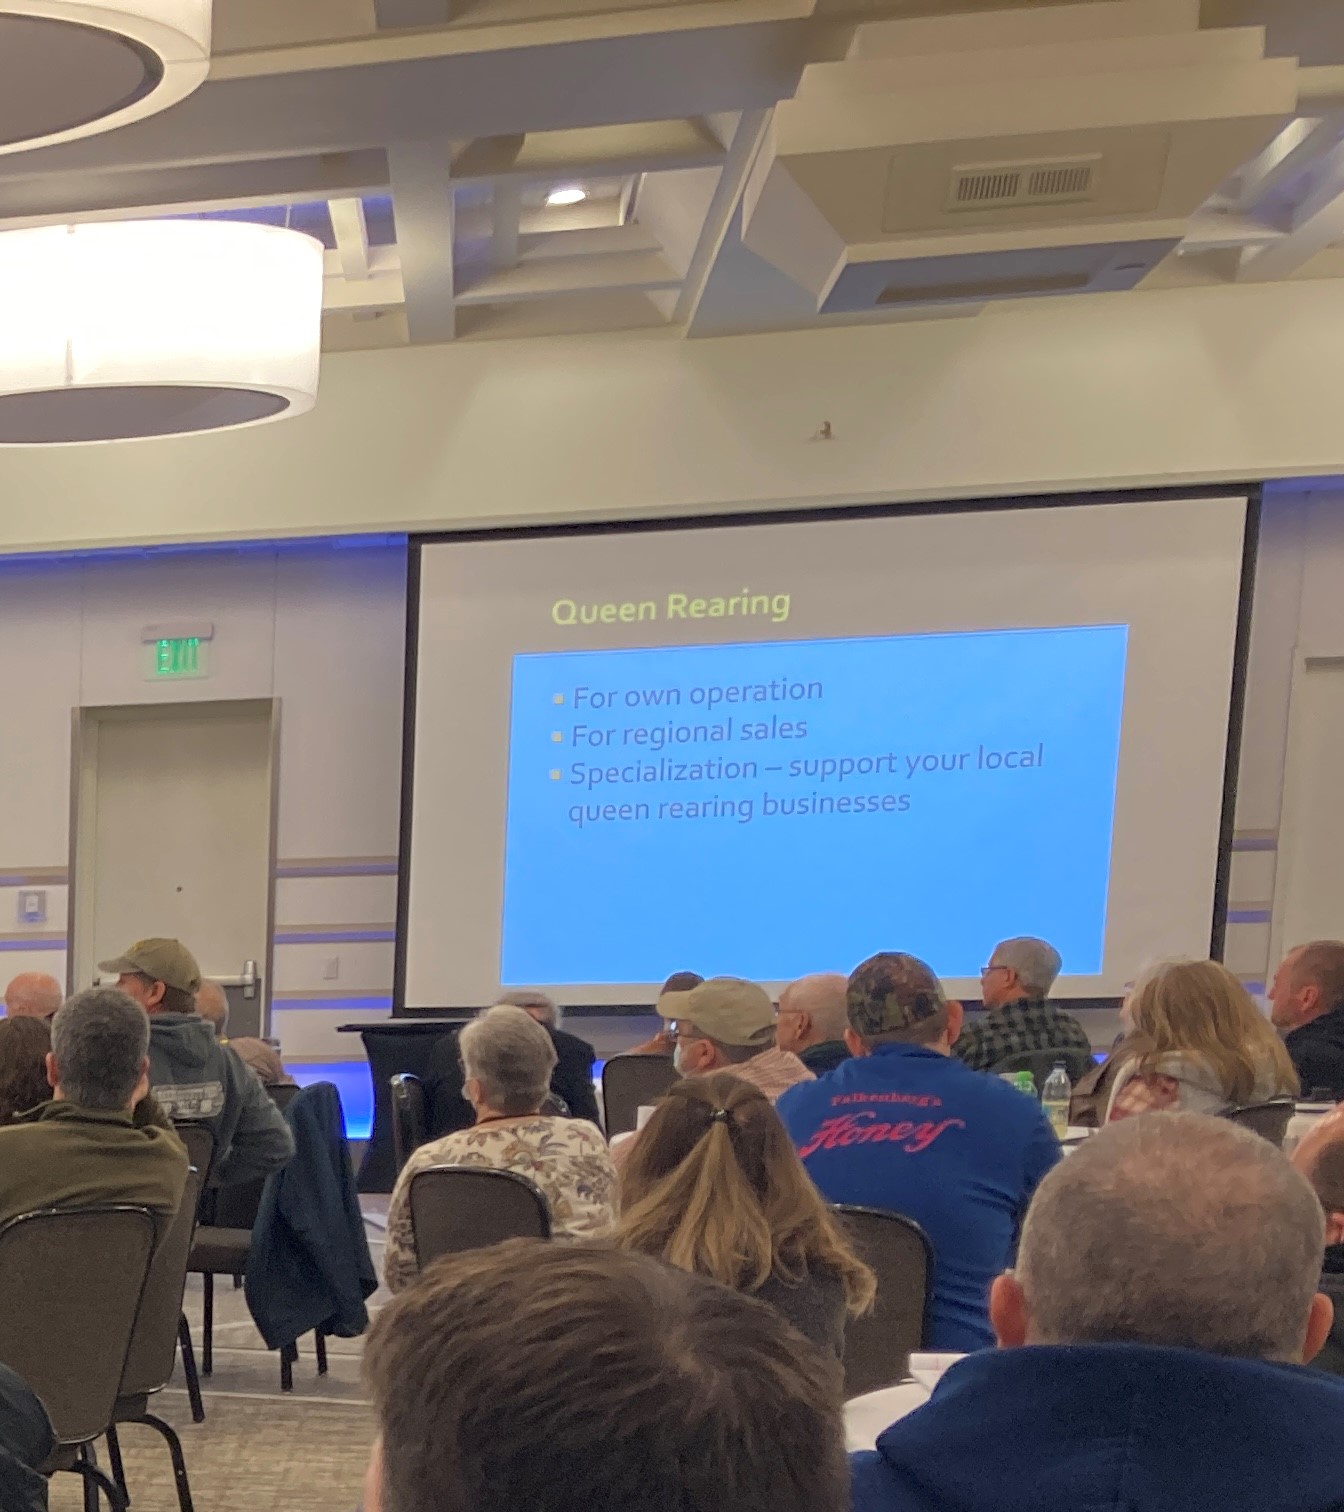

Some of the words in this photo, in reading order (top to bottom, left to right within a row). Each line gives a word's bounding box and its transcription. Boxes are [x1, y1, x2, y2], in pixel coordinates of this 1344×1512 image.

[551, 598, 656, 627] Queen
[667, 588, 791, 623] Rearing
[573, 687, 617, 710] For
[624, 686, 681, 708] own
[690, 677, 824, 710] operation
[571, 724, 616, 747] For
[623, 718, 732, 751] regional
[740, 716, 808, 742] sales
[570, 755, 757, 790] Specialization
[788, 751, 898, 783] support
[906, 752, 970, 779] your
[978, 743, 1044, 770] local
[568, 802, 650, 829] queen
[658, 794, 753, 824] rearing
[763, 792, 911, 817] businesses
[799, 1111, 965, 1158] Honey
